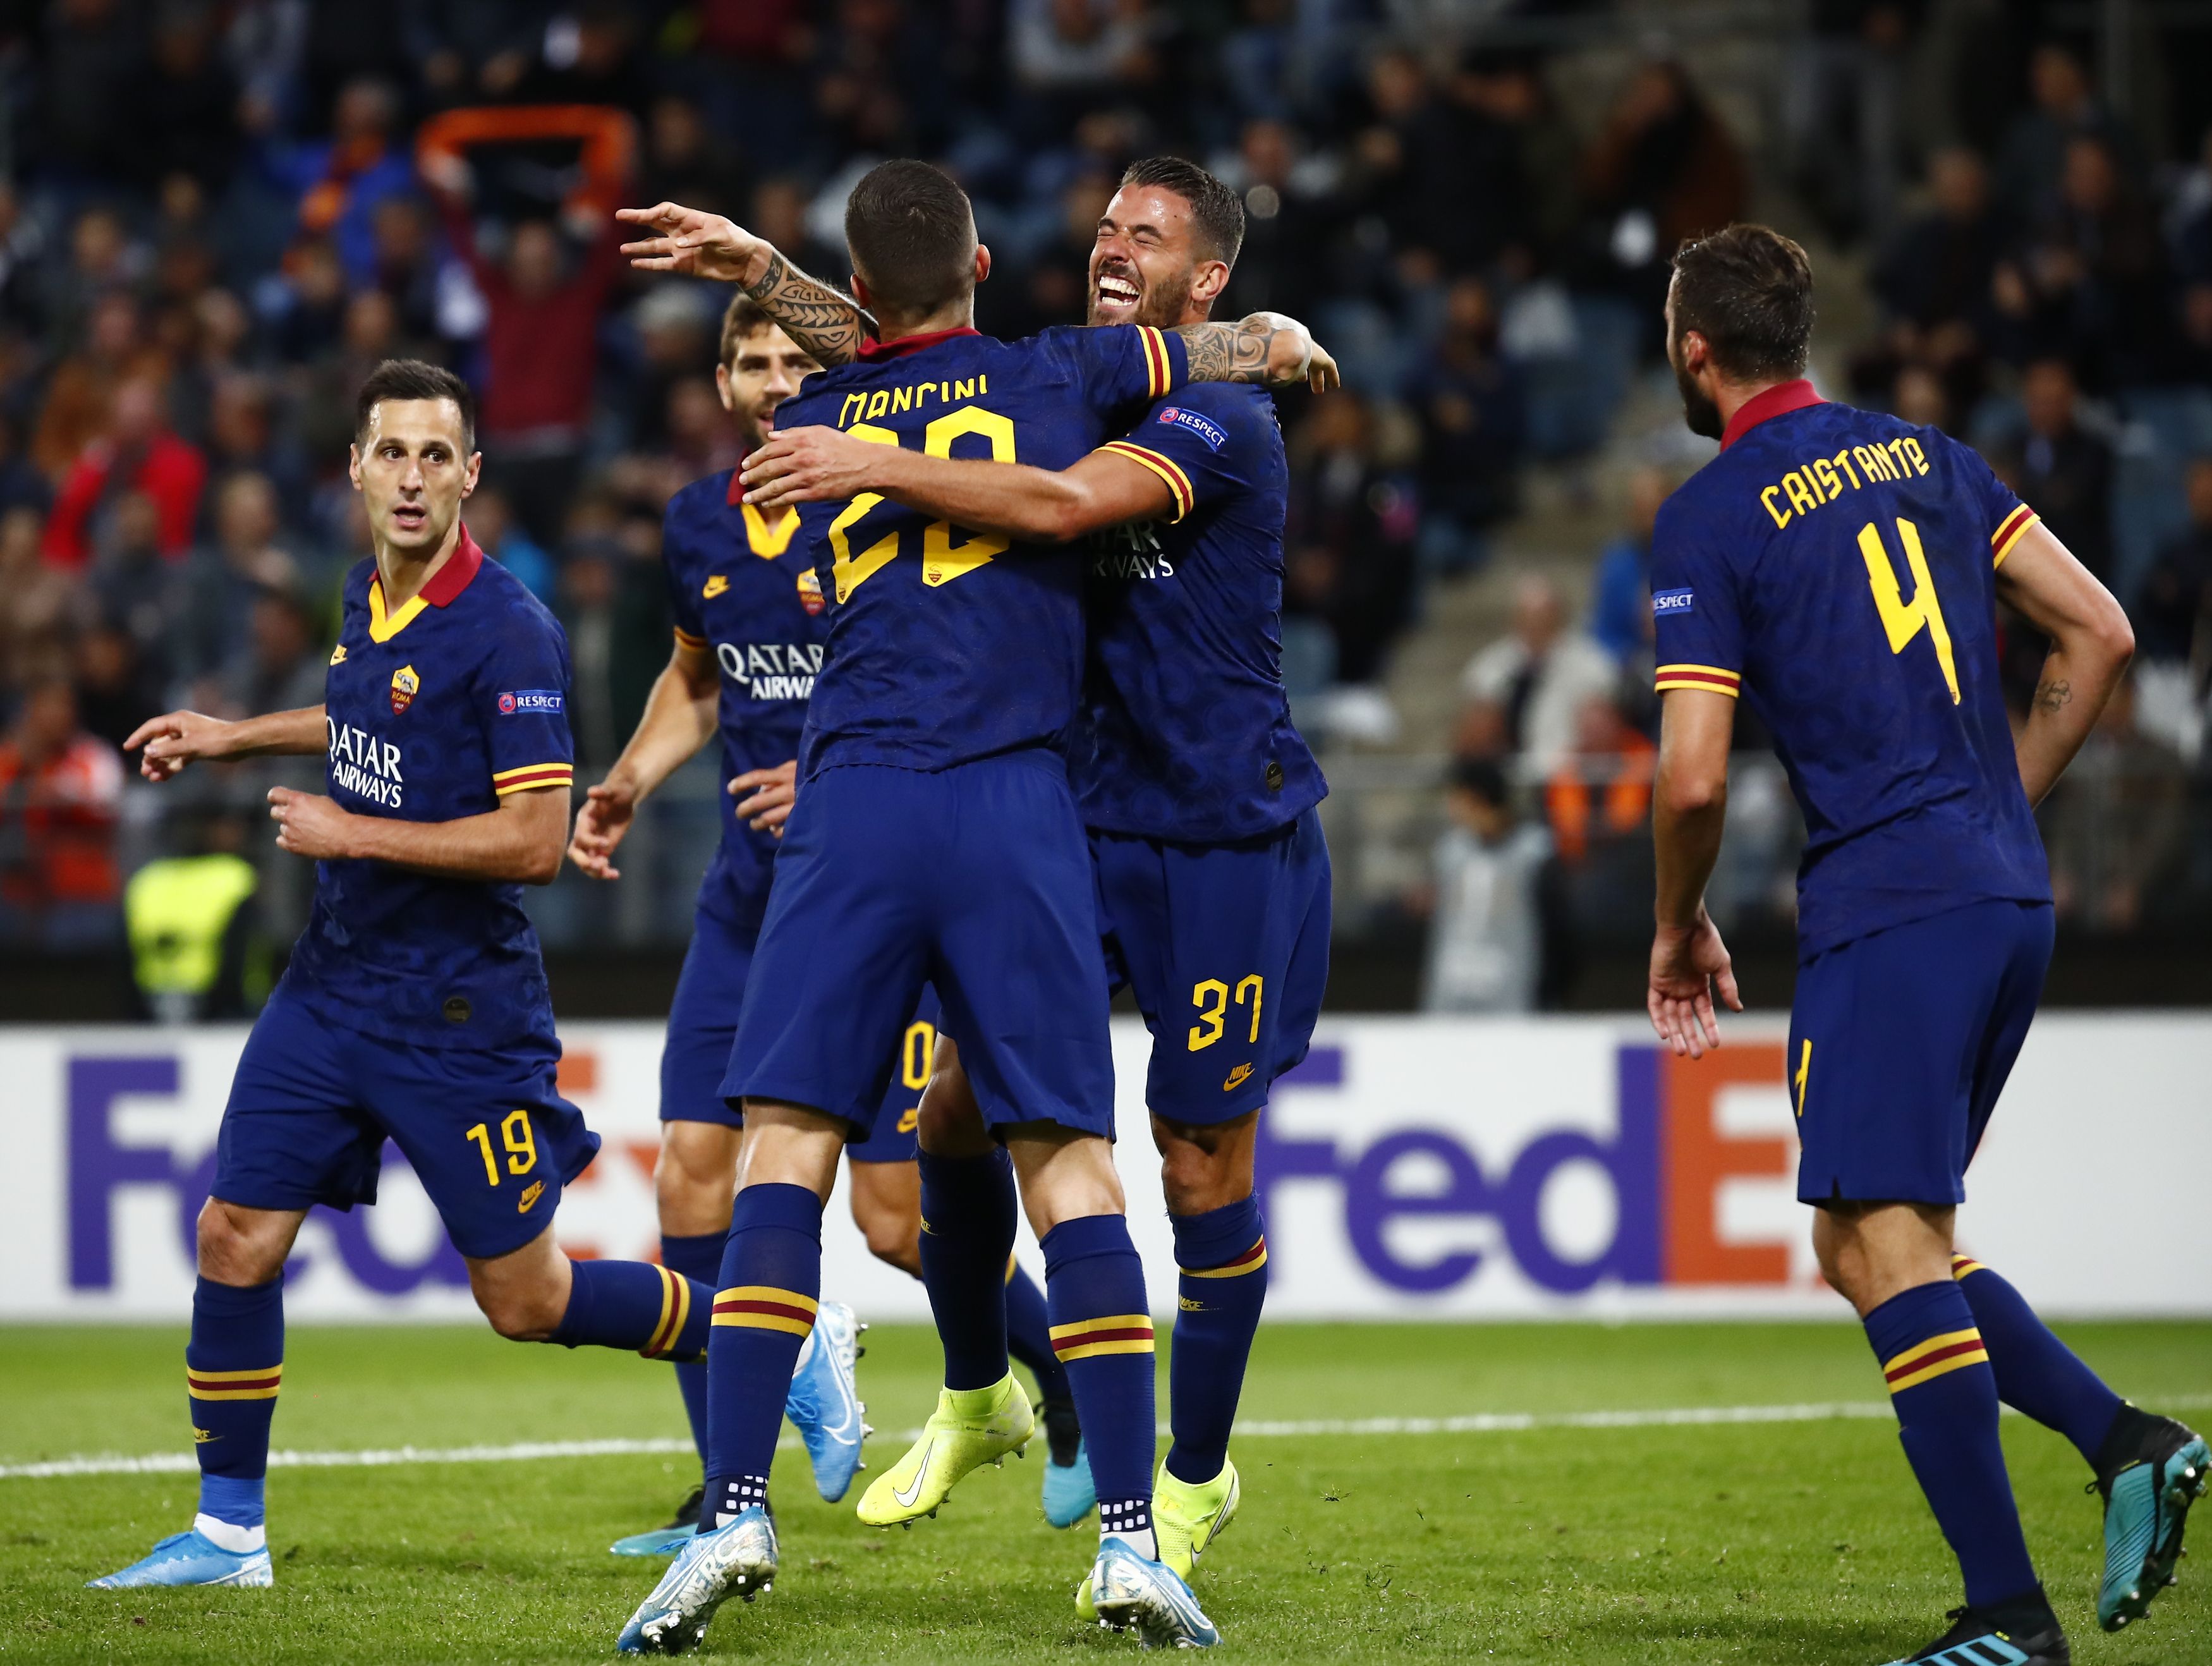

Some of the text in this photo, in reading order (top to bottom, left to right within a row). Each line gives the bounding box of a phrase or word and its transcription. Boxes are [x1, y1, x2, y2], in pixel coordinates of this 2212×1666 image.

[1177, 413, 1225, 446] RESPECT
[1653, 594, 1694, 611] ESPECT
[1856, 517, 1962, 705] 4
[391, 691, 411, 704] ROMA
[517, 696, 561, 708] RESPECT
[332, 761, 403, 809] AIRWAYS
[1188, 973, 1263, 1052] 37
[1229, 1062, 1252, 1081] NIKE
[466, 1109, 537, 1187] 19
[520, 1179, 543, 1203] NIKE
